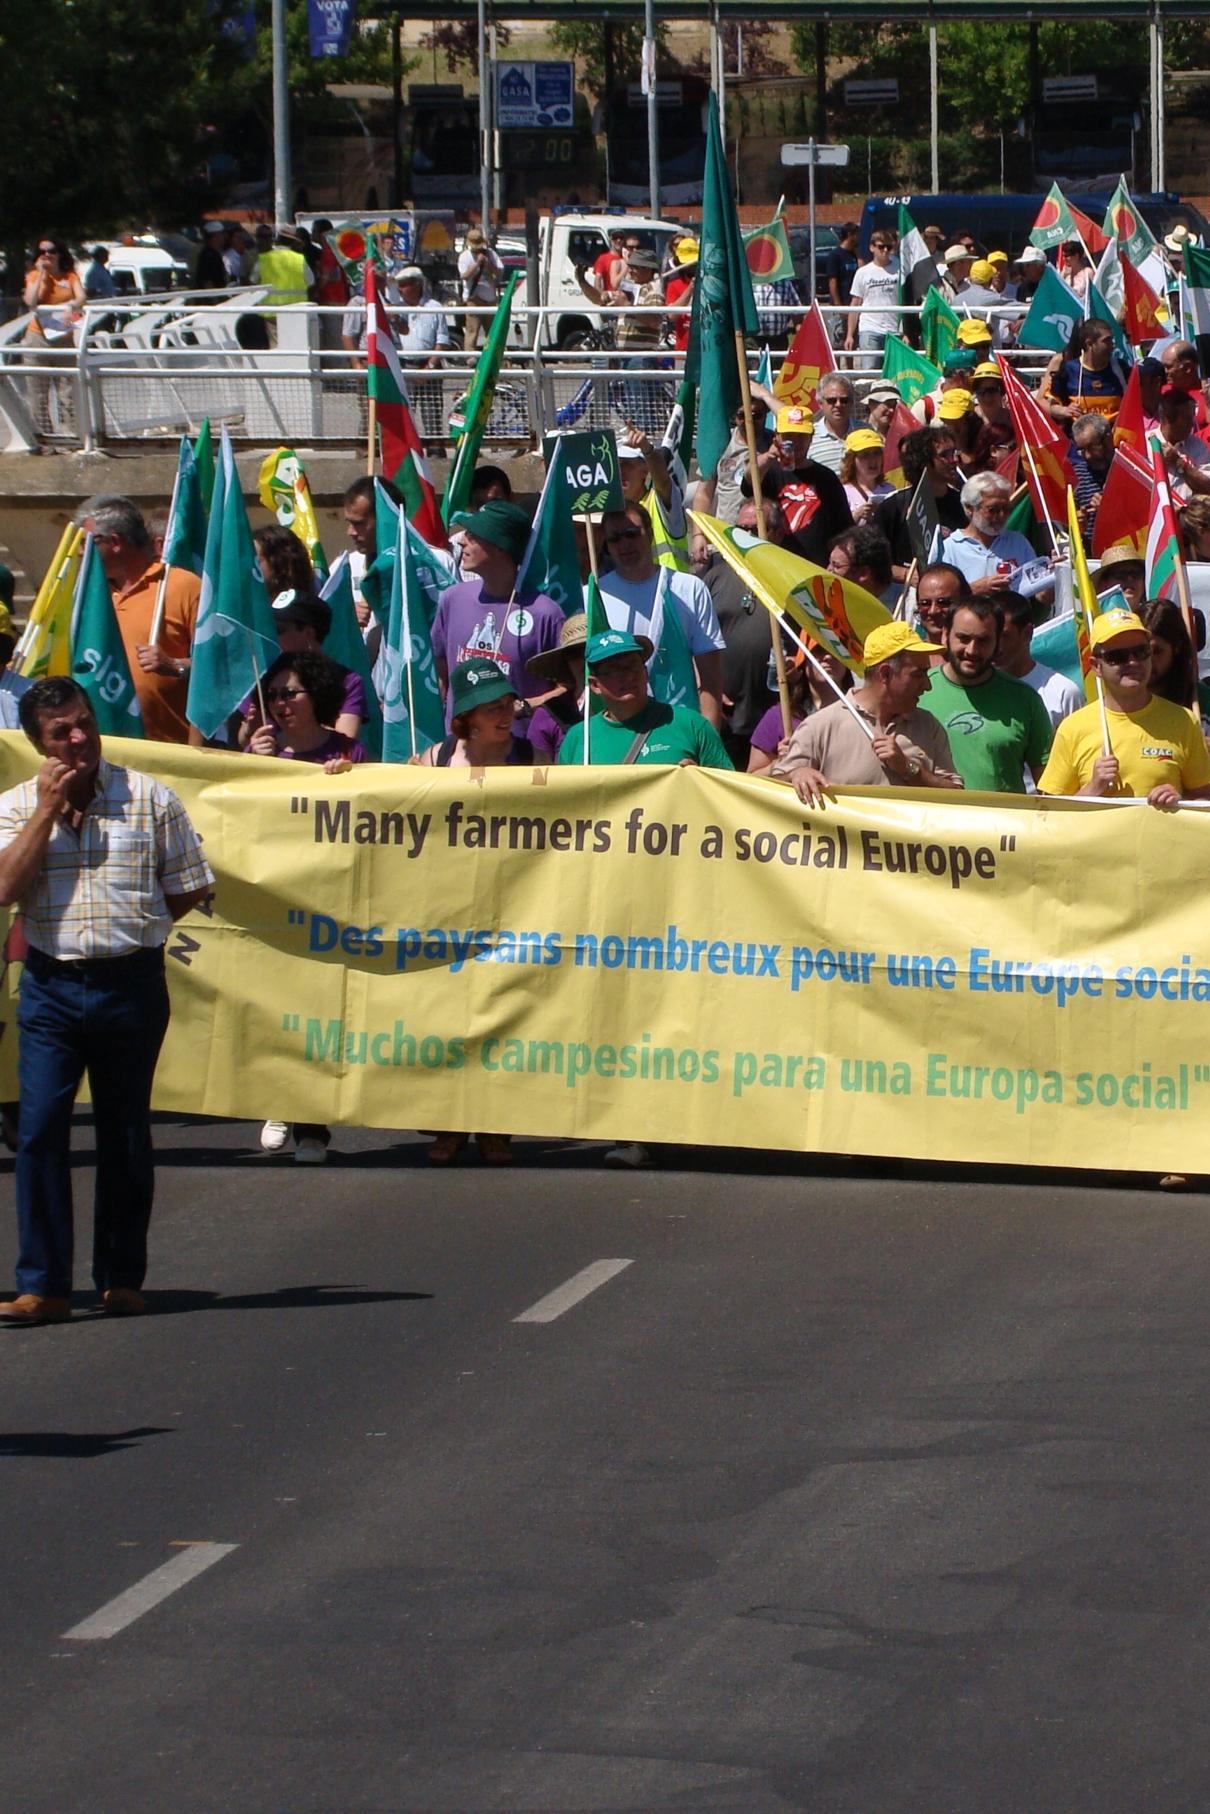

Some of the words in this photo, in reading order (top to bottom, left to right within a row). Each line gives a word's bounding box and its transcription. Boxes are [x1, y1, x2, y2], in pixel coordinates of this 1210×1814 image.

[316, 0, 348, 11] VOTA
[502, 86, 530, 97] CASA
[290, 796, 432, 859] "Many
[445, 801, 611, 853] farmers
[625, 808, 688, 856] for
[700, 824, 724, 859] a
[735, 822, 849, 870] social
[861, 830, 1017, 889] Europe"
[287, 909, 384, 957] "Des
[396, 926, 563, 974] paysans
[575, 925, 782, 978] nombreux
[791, 944, 876, 992] pour
[887, 953, 957, 990] une
[969, 947, 1103, 1008] Europe
[281, 1013, 467, 1070] "Muchos
[480, 1032, 720, 1088] campesinos
[733, 1050, 827, 1098] para
[841, 1056, 912, 1095] una
[926, 1053, 1064, 1115] Europa
[1076, 1062, 1210, 1111] social"
